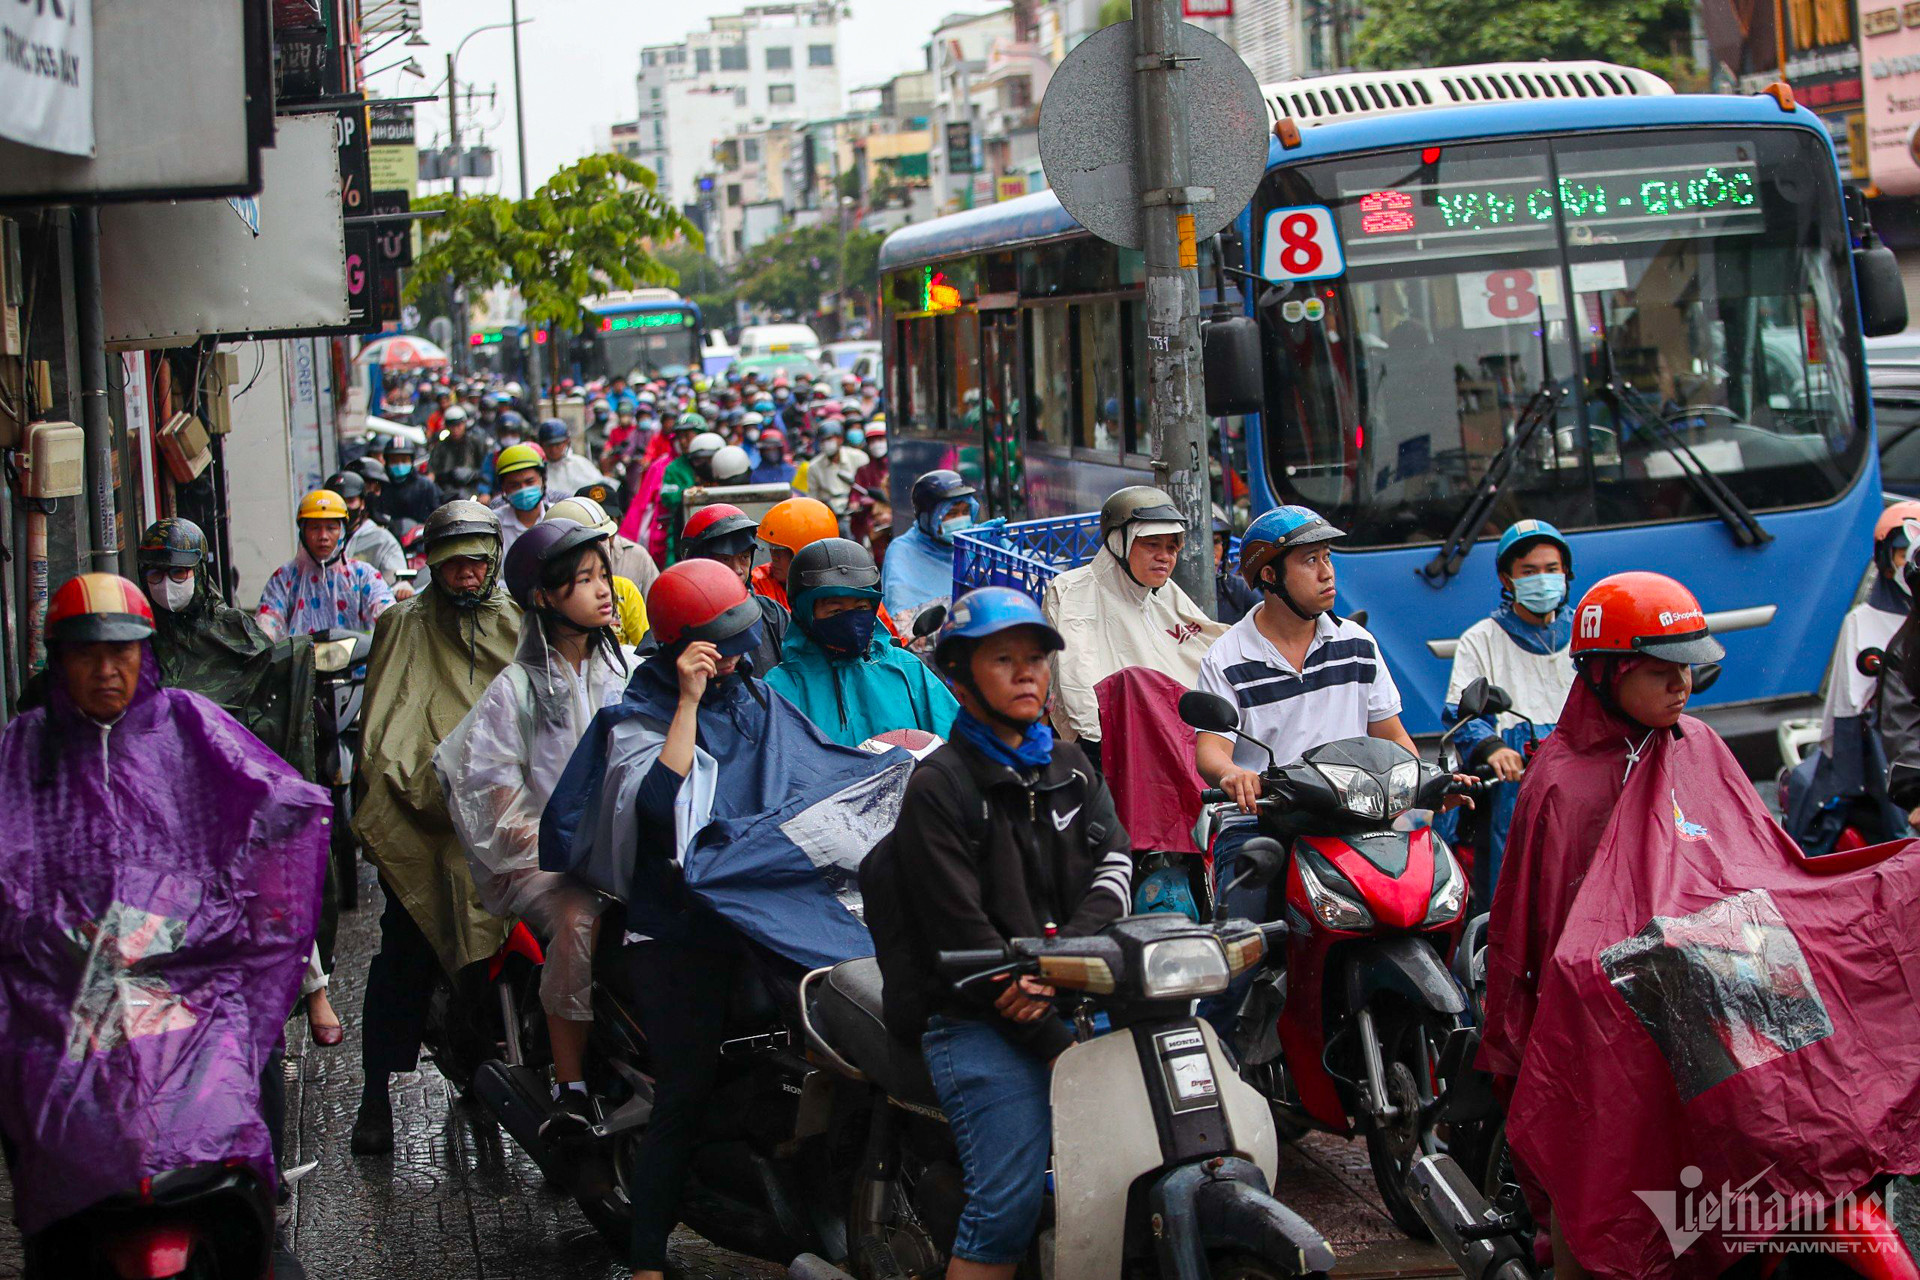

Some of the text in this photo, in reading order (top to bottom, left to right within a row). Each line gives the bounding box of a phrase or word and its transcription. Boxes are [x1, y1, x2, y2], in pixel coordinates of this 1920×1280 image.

[1280, 213, 1323, 275] 8
[1485, 268, 1539, 319] 8
[1361, 831, 1397, 840] HONDA
[1169, 1038, 1201, 1048] HONDA
[911, 1103, 944, 1119] HONDA
